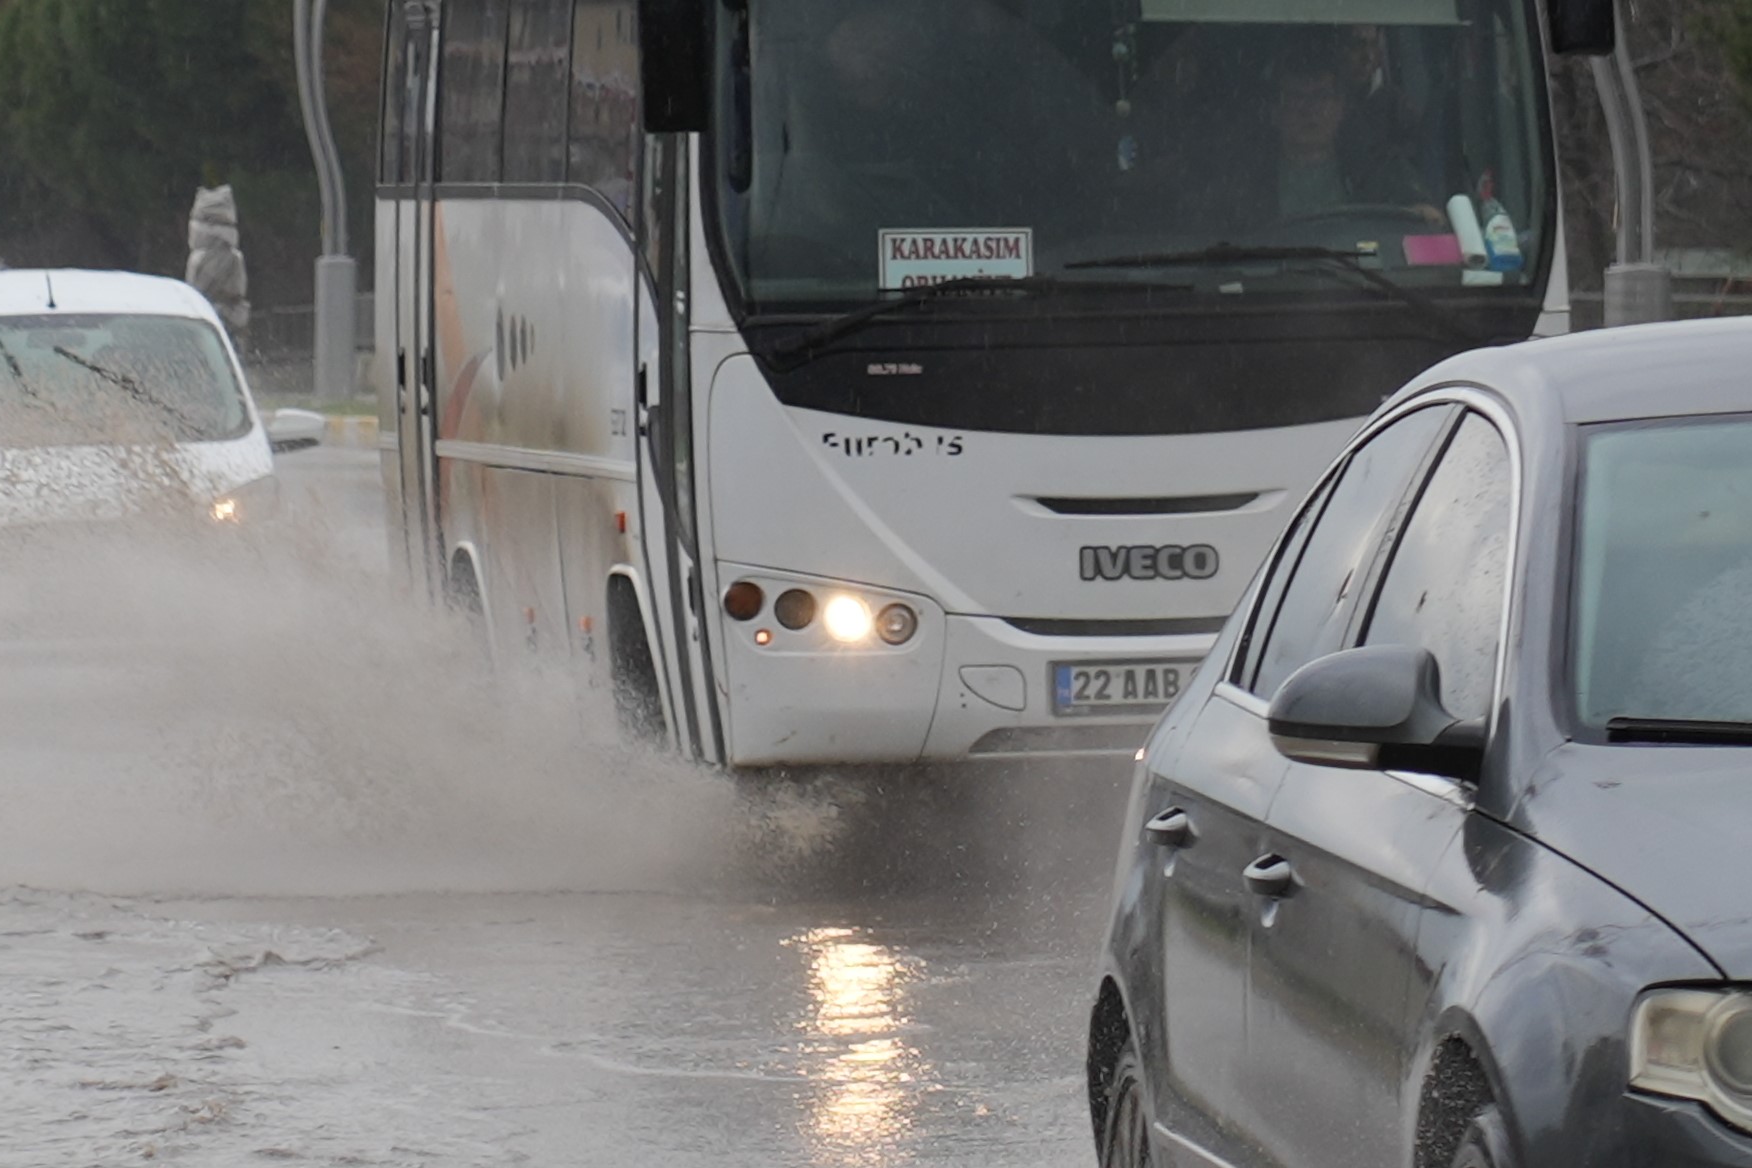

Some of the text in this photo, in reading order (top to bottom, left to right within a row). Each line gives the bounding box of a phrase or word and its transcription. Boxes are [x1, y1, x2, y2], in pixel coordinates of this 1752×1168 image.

[890, 236, 1022, 260] KARAKASIM
[1079, 544, 1220, 581] IVECO
[1073, 670, 1112, 700] 22
[1122, 667, 1180, 700] AAB
